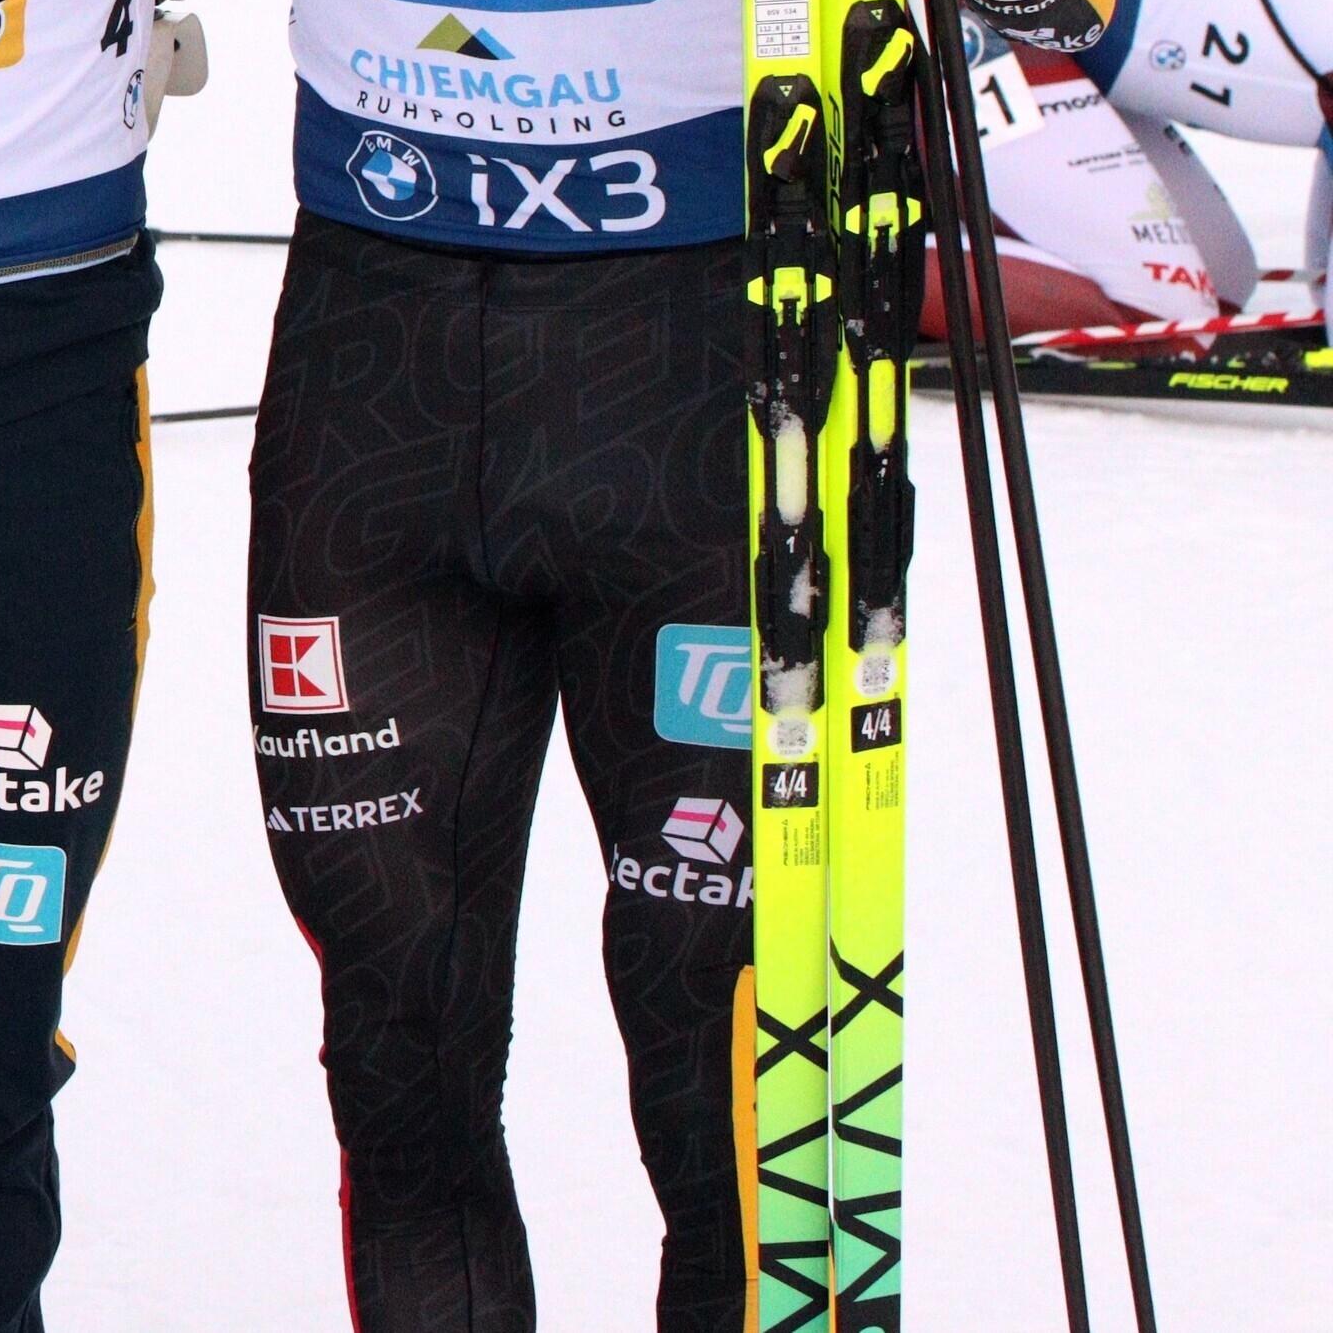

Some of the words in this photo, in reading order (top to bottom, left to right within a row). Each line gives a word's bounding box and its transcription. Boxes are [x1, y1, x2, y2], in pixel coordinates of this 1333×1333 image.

[350, 49, 621, 109] CHIEMGAU
[357, 91, 626, 134] RUHPOLDING
[979, 74, 1016, 137] 1
[466, 148, 667, 234] iX3
[1169, 372, 1290, 393] FISCHER
[860, 712, 892, 741] 4/4
[773, 769, 808, 800] 4/4
[289, 787, 425, 833] TERREX
[611, 842, 757, 909] tectak
